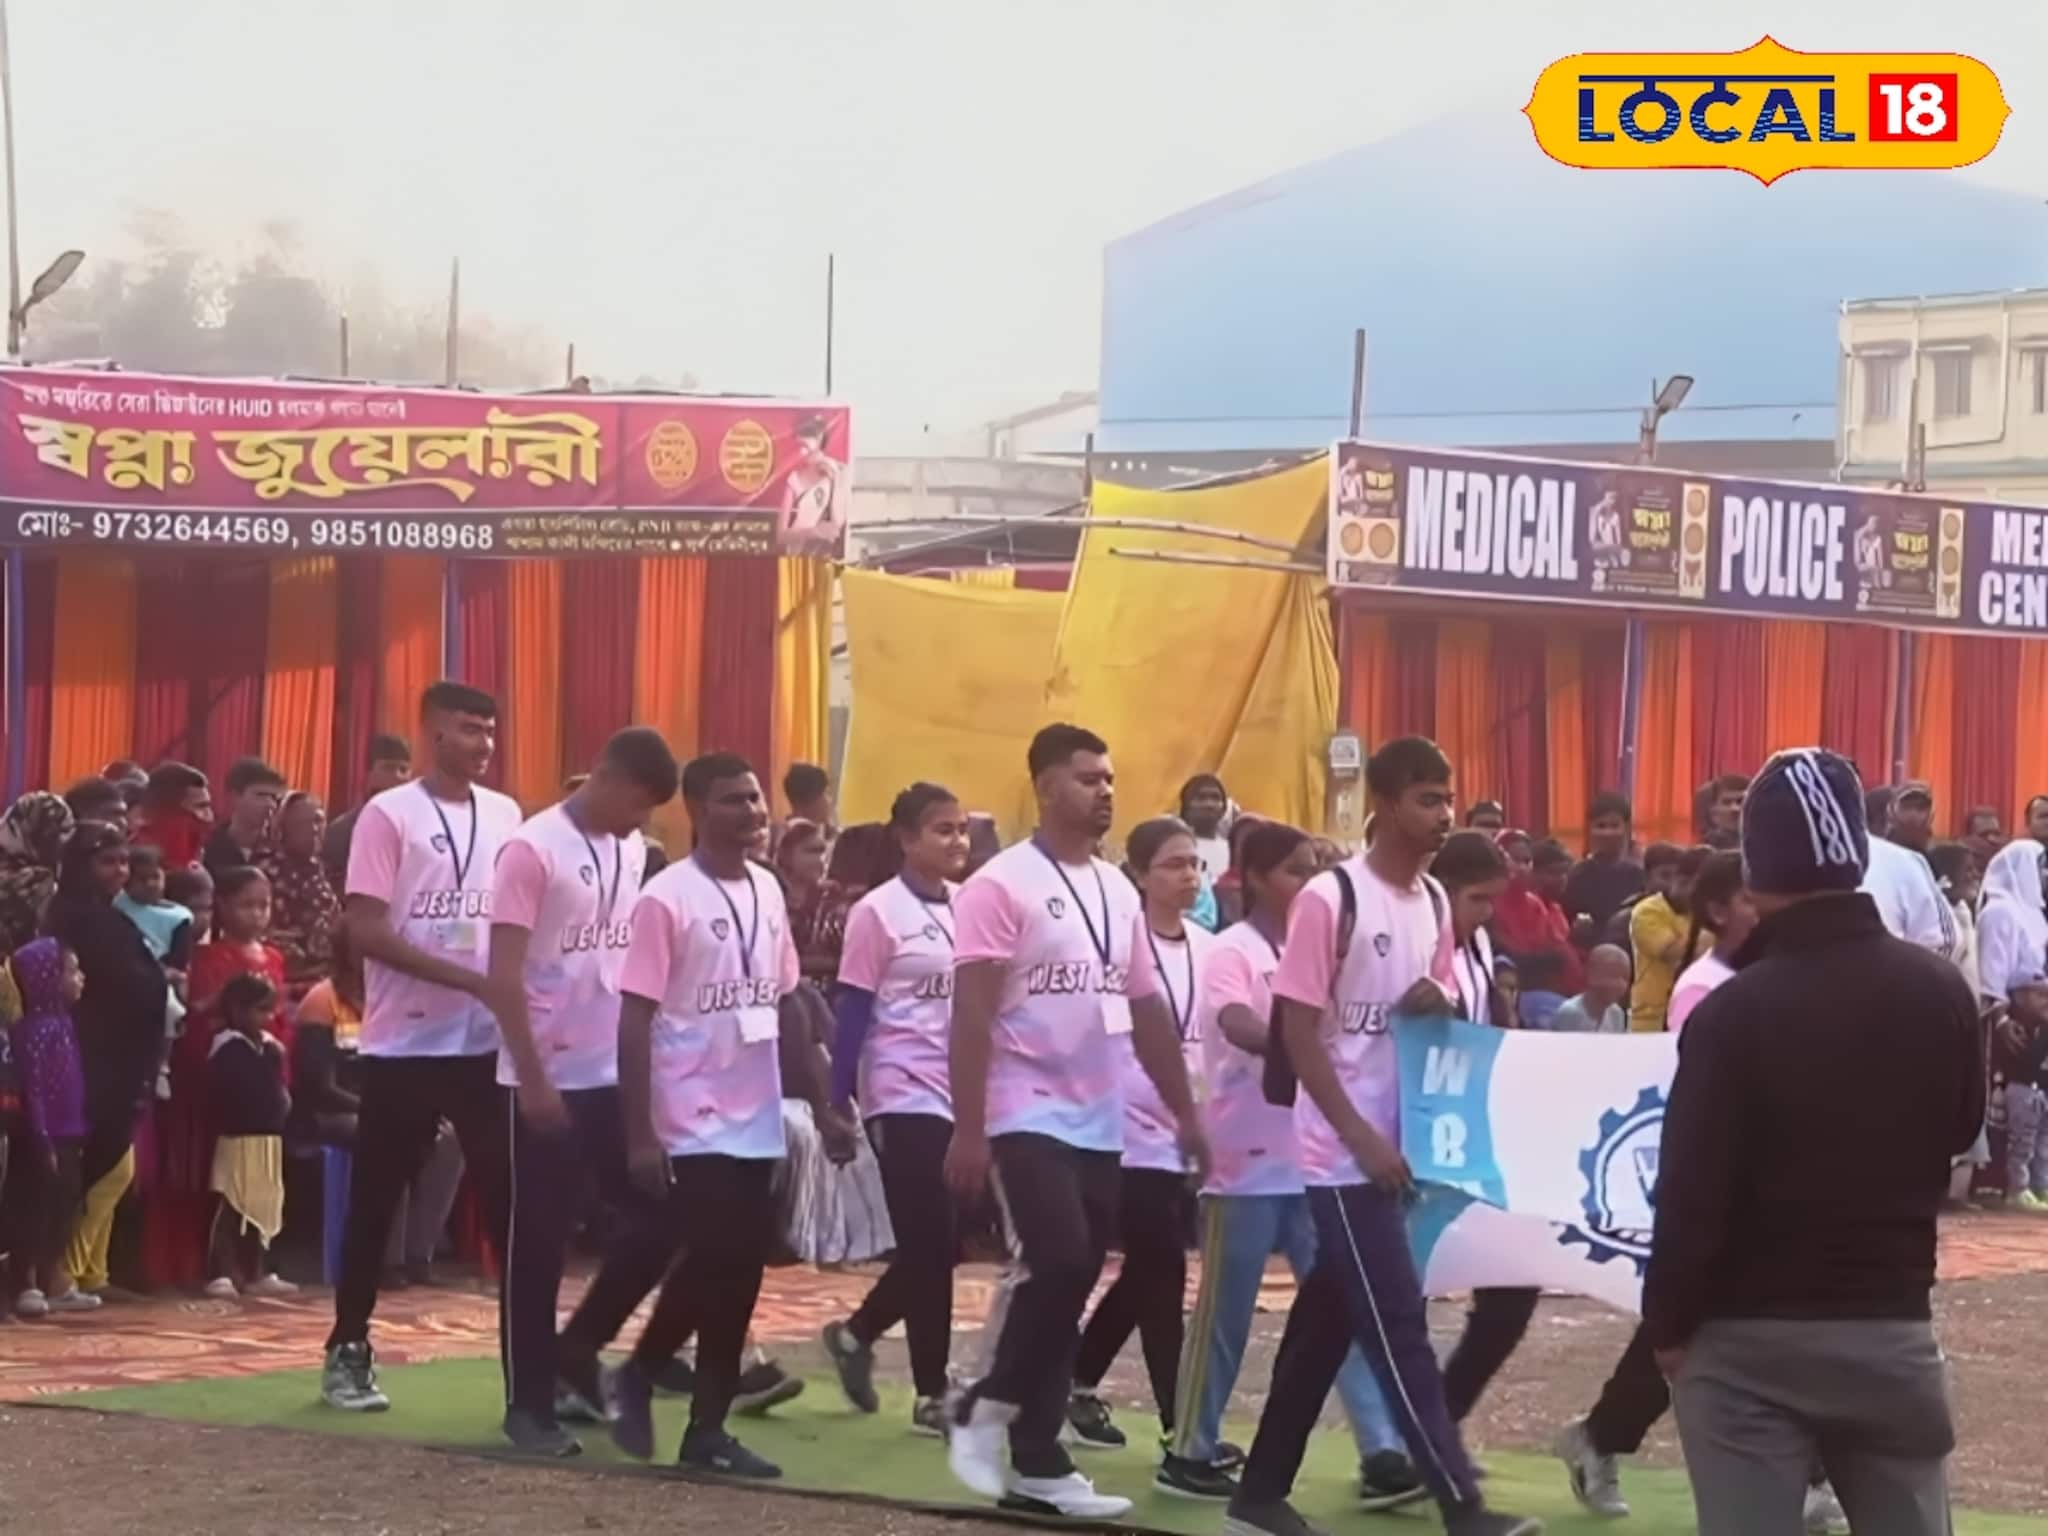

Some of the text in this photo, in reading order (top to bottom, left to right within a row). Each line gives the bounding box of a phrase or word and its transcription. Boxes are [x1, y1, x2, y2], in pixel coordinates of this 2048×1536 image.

[228, 398, 272, 418] HUID
[92, 512, 299, 549] 9732644569,
[310, 518, 494, 551] 9851088968
[1404, 465, 1578, 582] MEDICAL
[1719, 496, 1846, 601] POLICE
[1978, 570, 2048, 628] CEN
[1028, 961, 1089, 995] WEST
